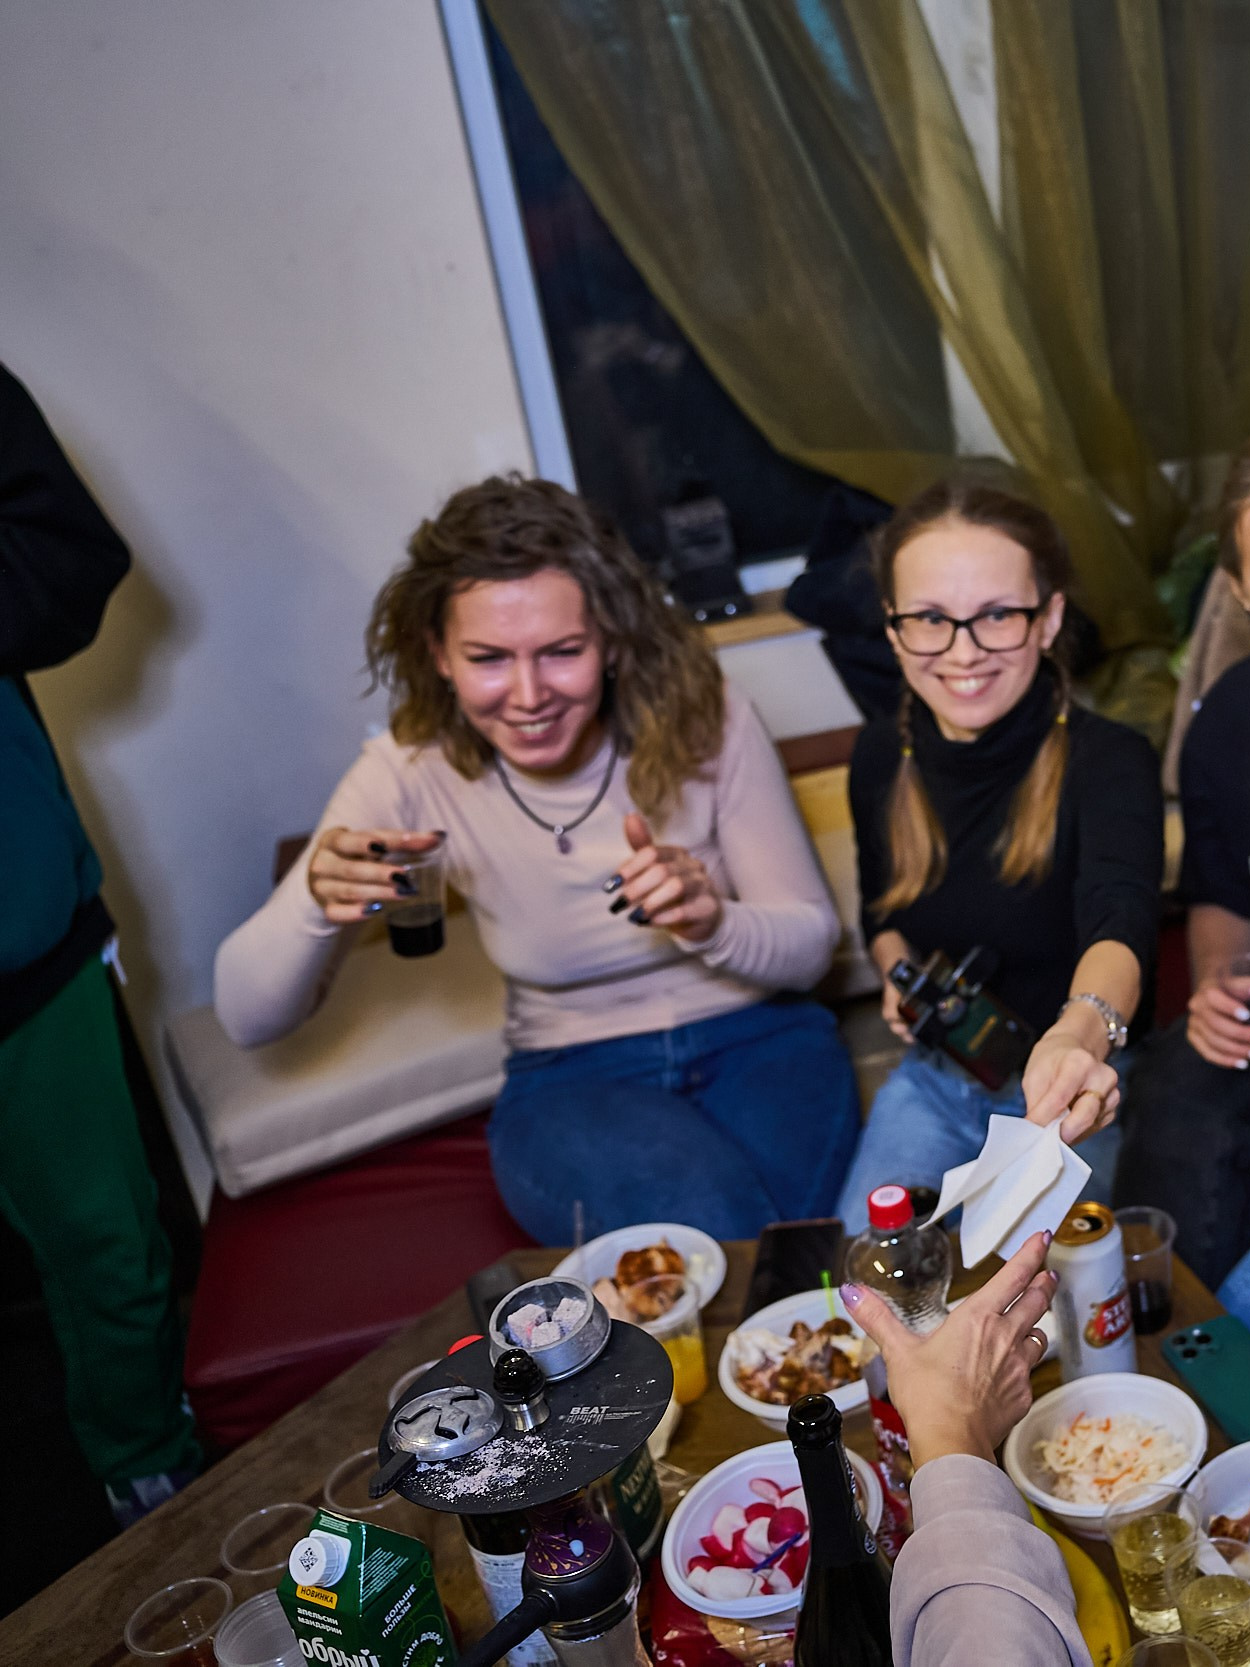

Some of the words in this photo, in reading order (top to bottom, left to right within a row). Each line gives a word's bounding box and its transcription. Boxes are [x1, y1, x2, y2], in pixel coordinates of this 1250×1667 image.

[570, 1406, 610, 1415] BEAT
[300, 1586, 334, 1604] НОВИНКА
[384, 1583, 417, 1624] БОЛЬШЕ
[297, 1607, 339, 1626] апельсин
[297, 1616, 343, 1636] мандарин
[381, 1601, 412, 1638] ПОЛЬЗЫ
